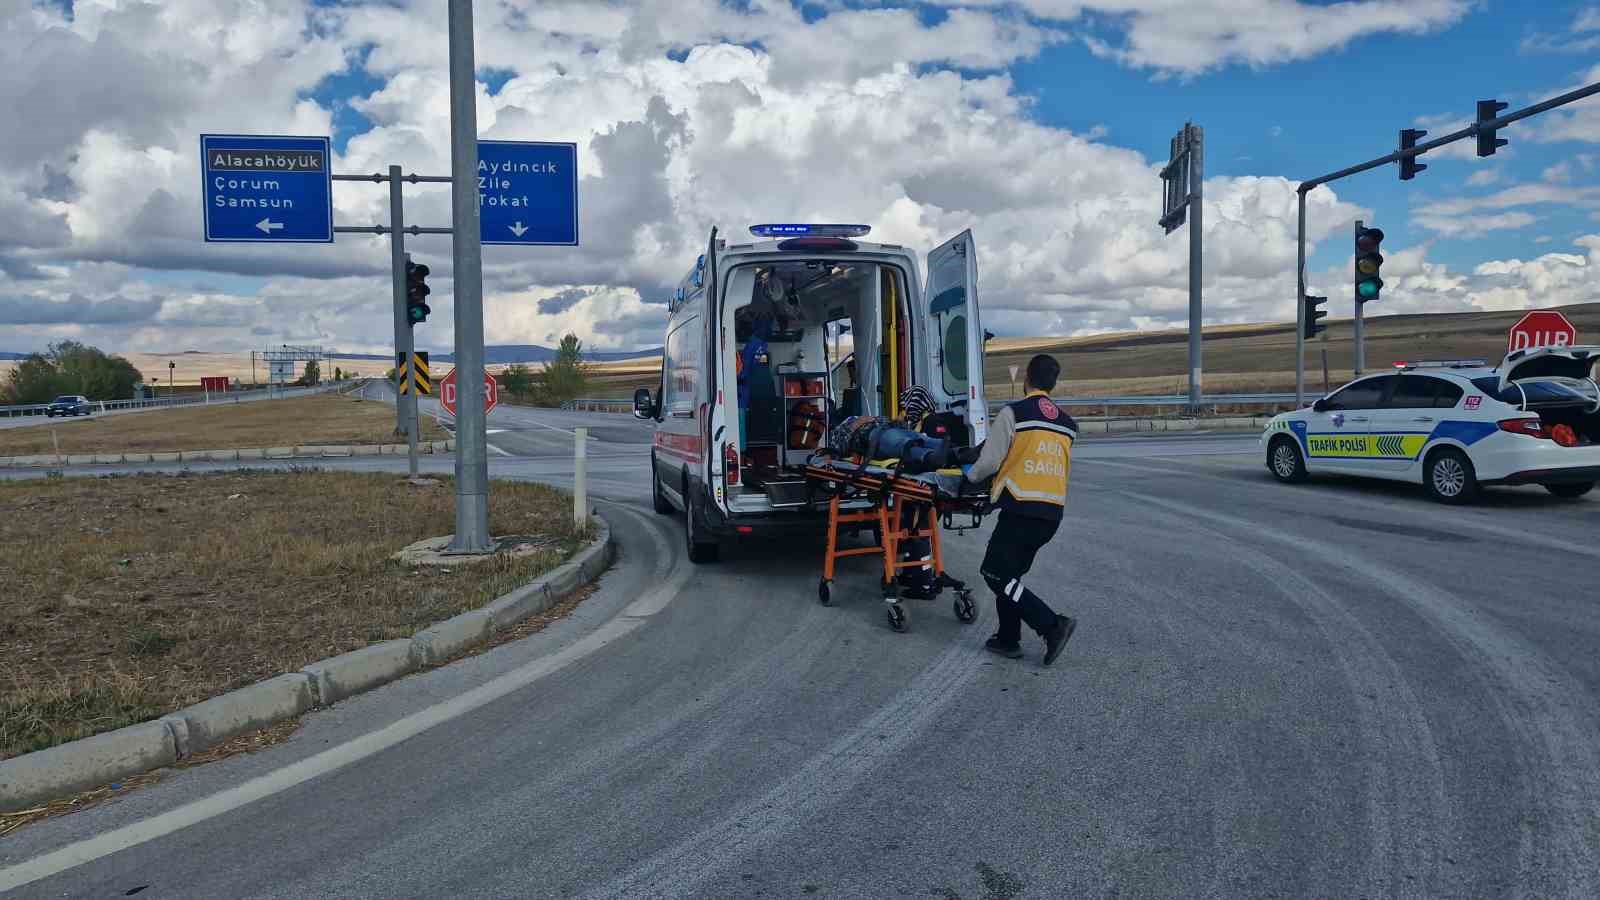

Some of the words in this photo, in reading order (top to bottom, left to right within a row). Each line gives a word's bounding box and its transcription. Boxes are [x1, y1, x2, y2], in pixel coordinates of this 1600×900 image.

[214, 154, 319, 170] Alacahöyük
[478, 159, 557, 175] Aydıncık
[215, 176, 279, 191] Çorum
[215, 195, 293, 208] Samsun
[479, 193, 529, 207] Tokat
[445, 383, 492, 403] DR
